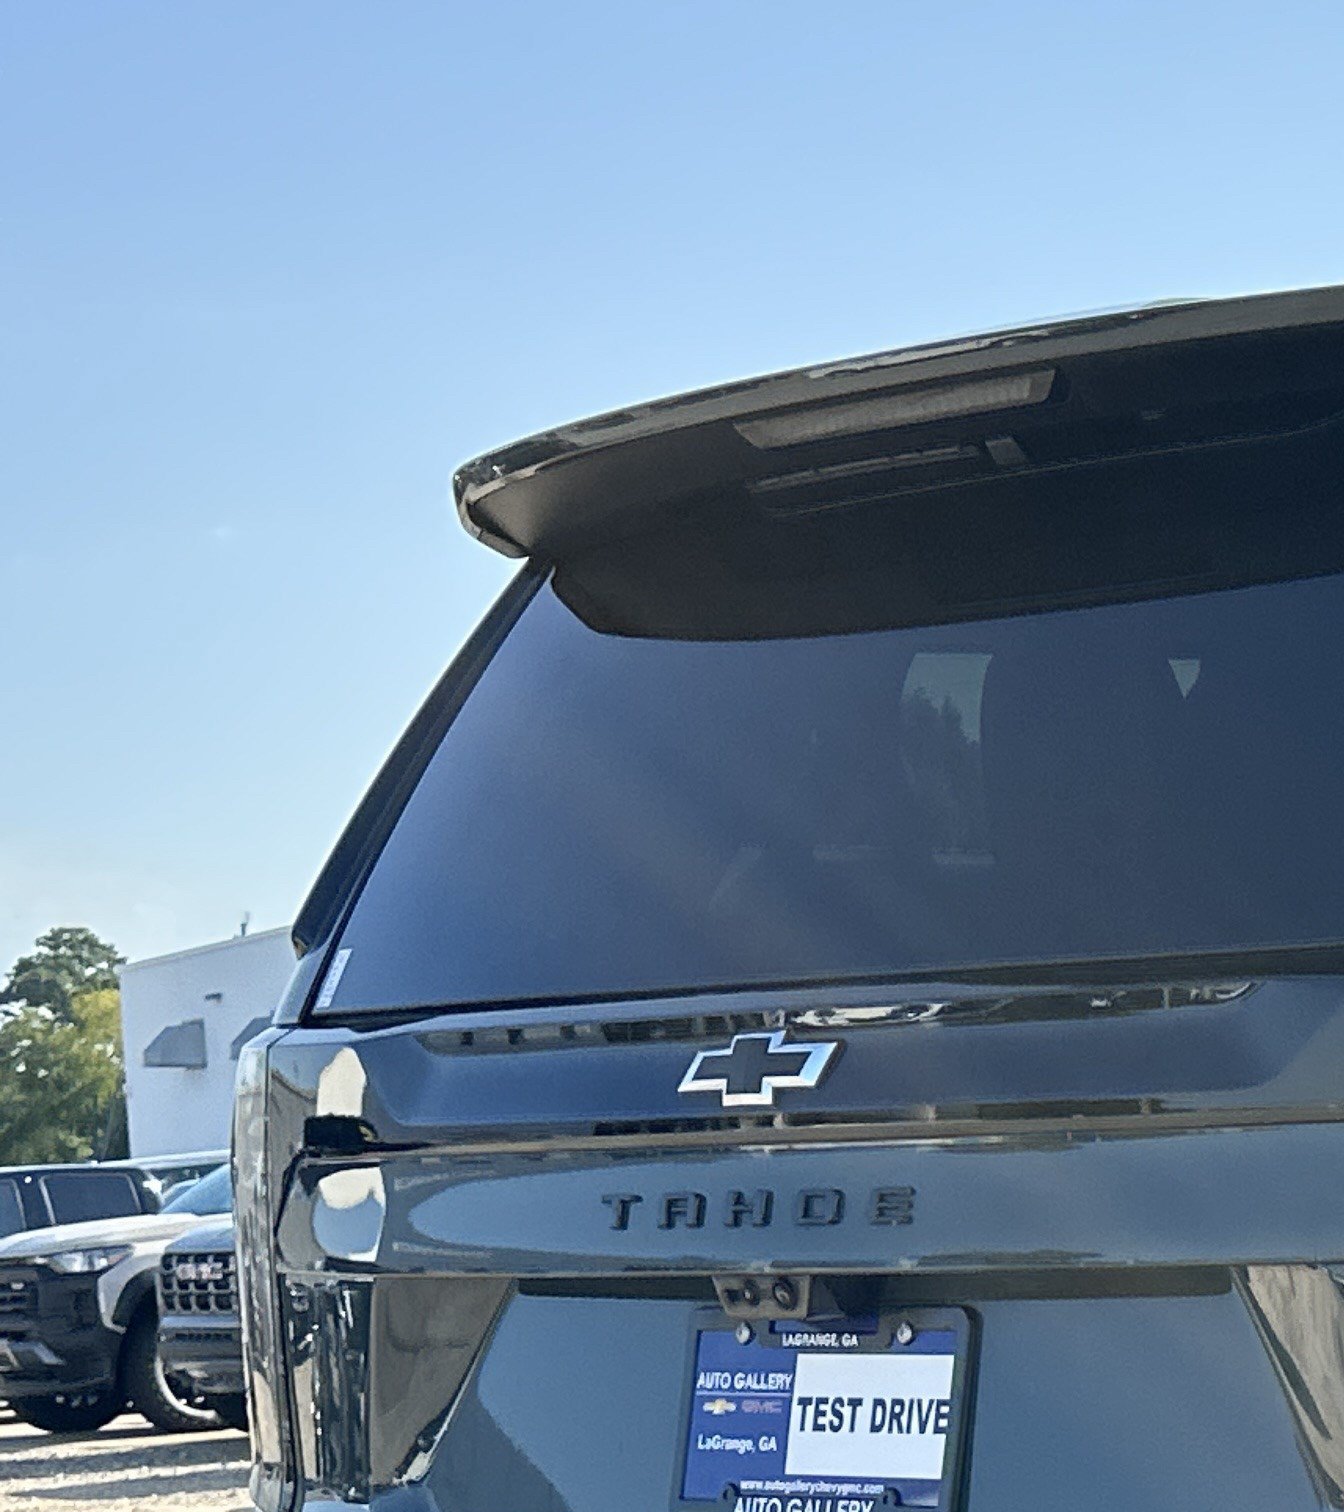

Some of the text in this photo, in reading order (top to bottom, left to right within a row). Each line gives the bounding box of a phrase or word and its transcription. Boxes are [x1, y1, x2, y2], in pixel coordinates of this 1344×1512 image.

[602, 1186, 916, 1231] TAHOE
[841, 1332, 859, 1347] GA
[696, 1371, 793, 1390] AUTO GALLERY
[741, 1399, 783, 1413] GMC
[797, 1396, 951, 1435] TEST DRIVE
[758, 1435, 777, 1452] GA
